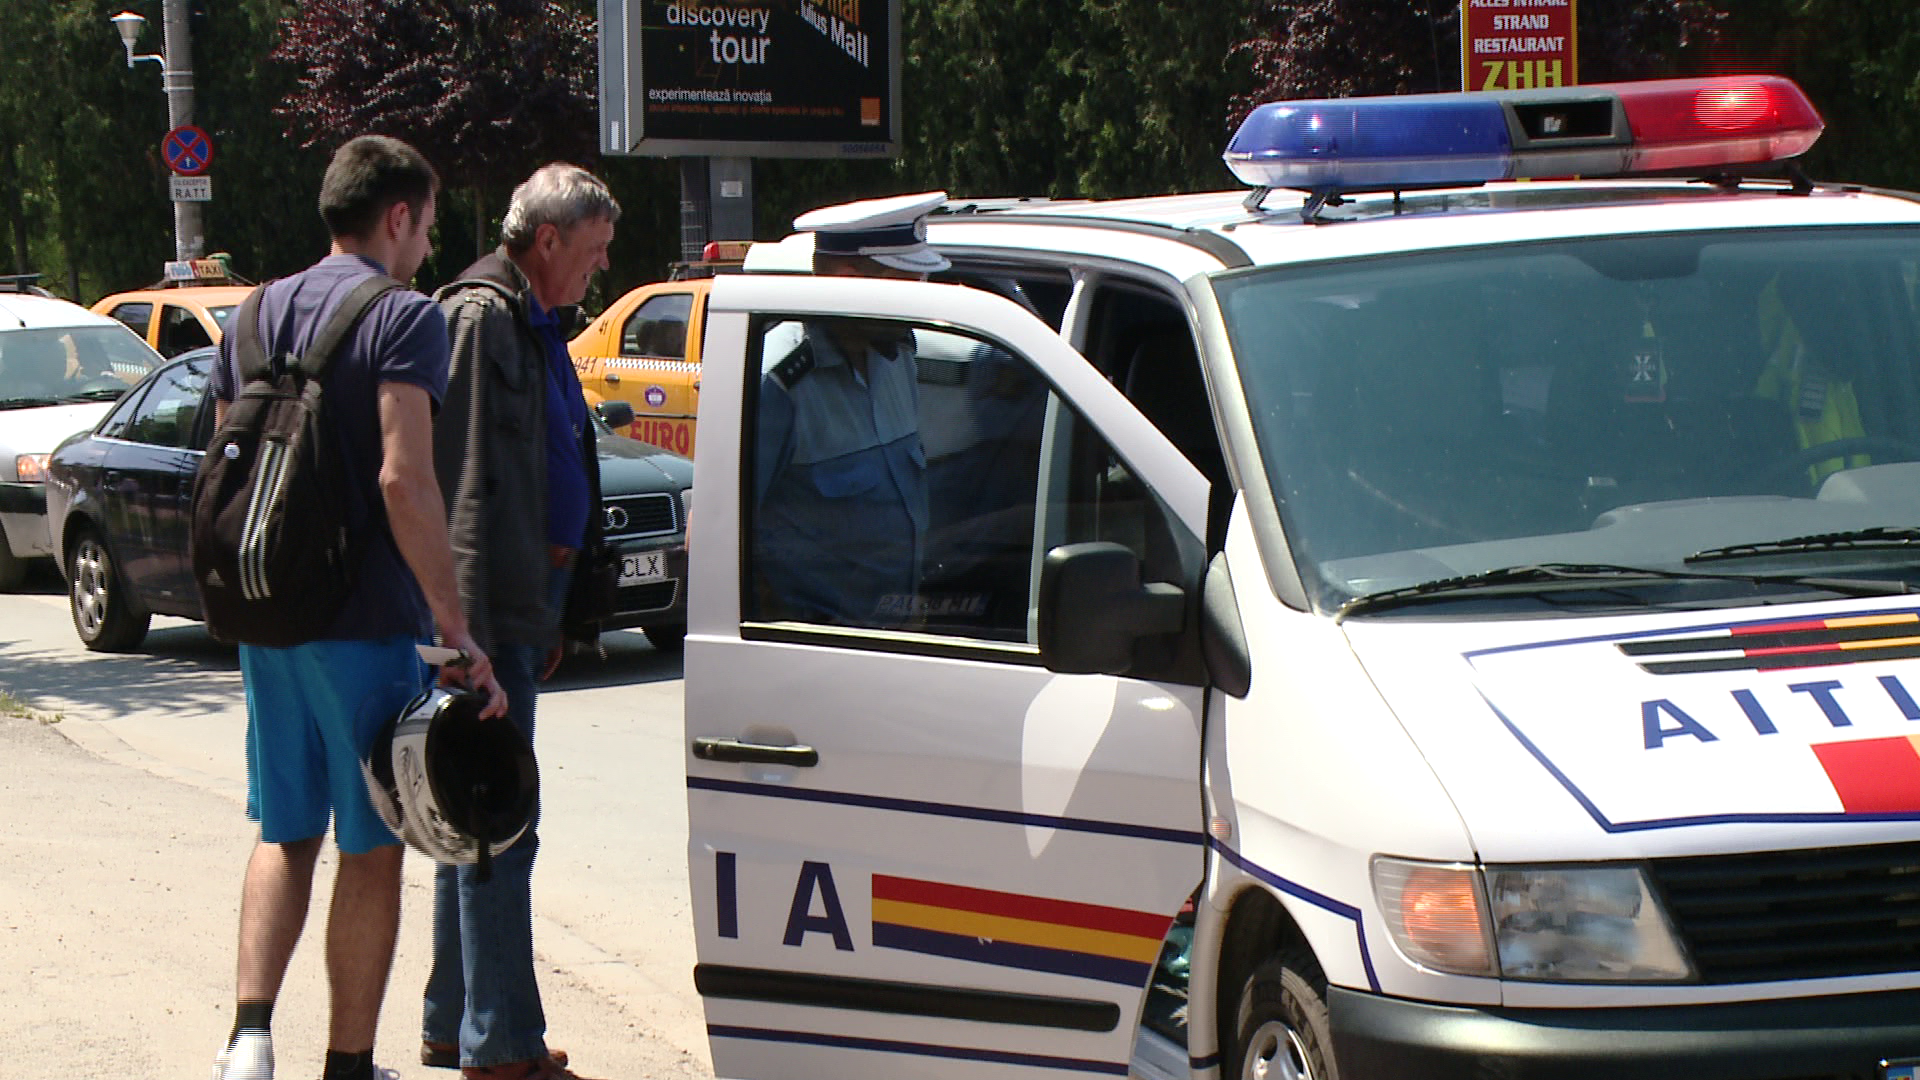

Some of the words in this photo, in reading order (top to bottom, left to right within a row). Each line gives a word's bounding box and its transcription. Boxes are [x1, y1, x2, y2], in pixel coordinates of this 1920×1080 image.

[666, 0, 770, 34] discovery
[1493, 14, 1550, 30] STRAND
[709, 29, 771, 64] tour
[830, 15, 869, 69] Mall
[1473, 36, 1566, 54] RESTAURANT
[1481, 60, 1563, 91] ZHH
[199, 264, 223, 275] TAXI
[629, 420, 690, 455] EURO
[624, 556, 660, 577] CLX
